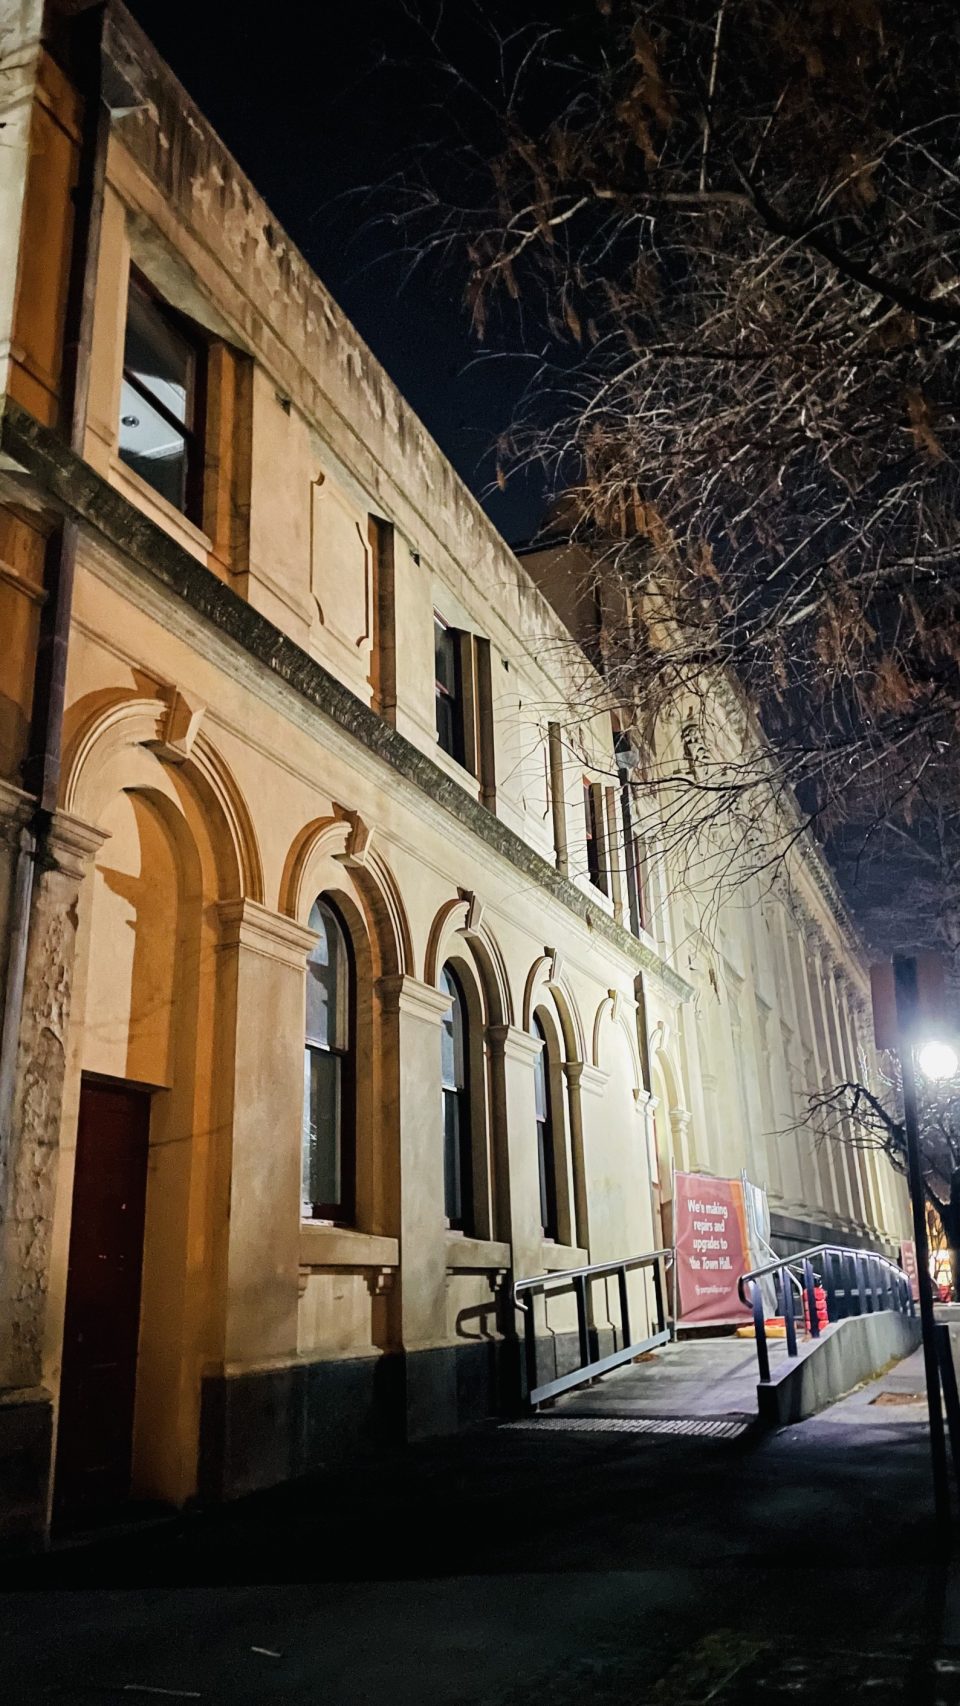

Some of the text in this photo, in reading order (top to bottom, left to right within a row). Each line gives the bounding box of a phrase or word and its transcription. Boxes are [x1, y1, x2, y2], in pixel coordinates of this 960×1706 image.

[705, 1201, 728, 1219] making
[694, 1219, 725, 1235] repairs and
[693, 1236, 728, 1253] upgrades to
[689, 1256, 733, 1270] the Town Hall.
